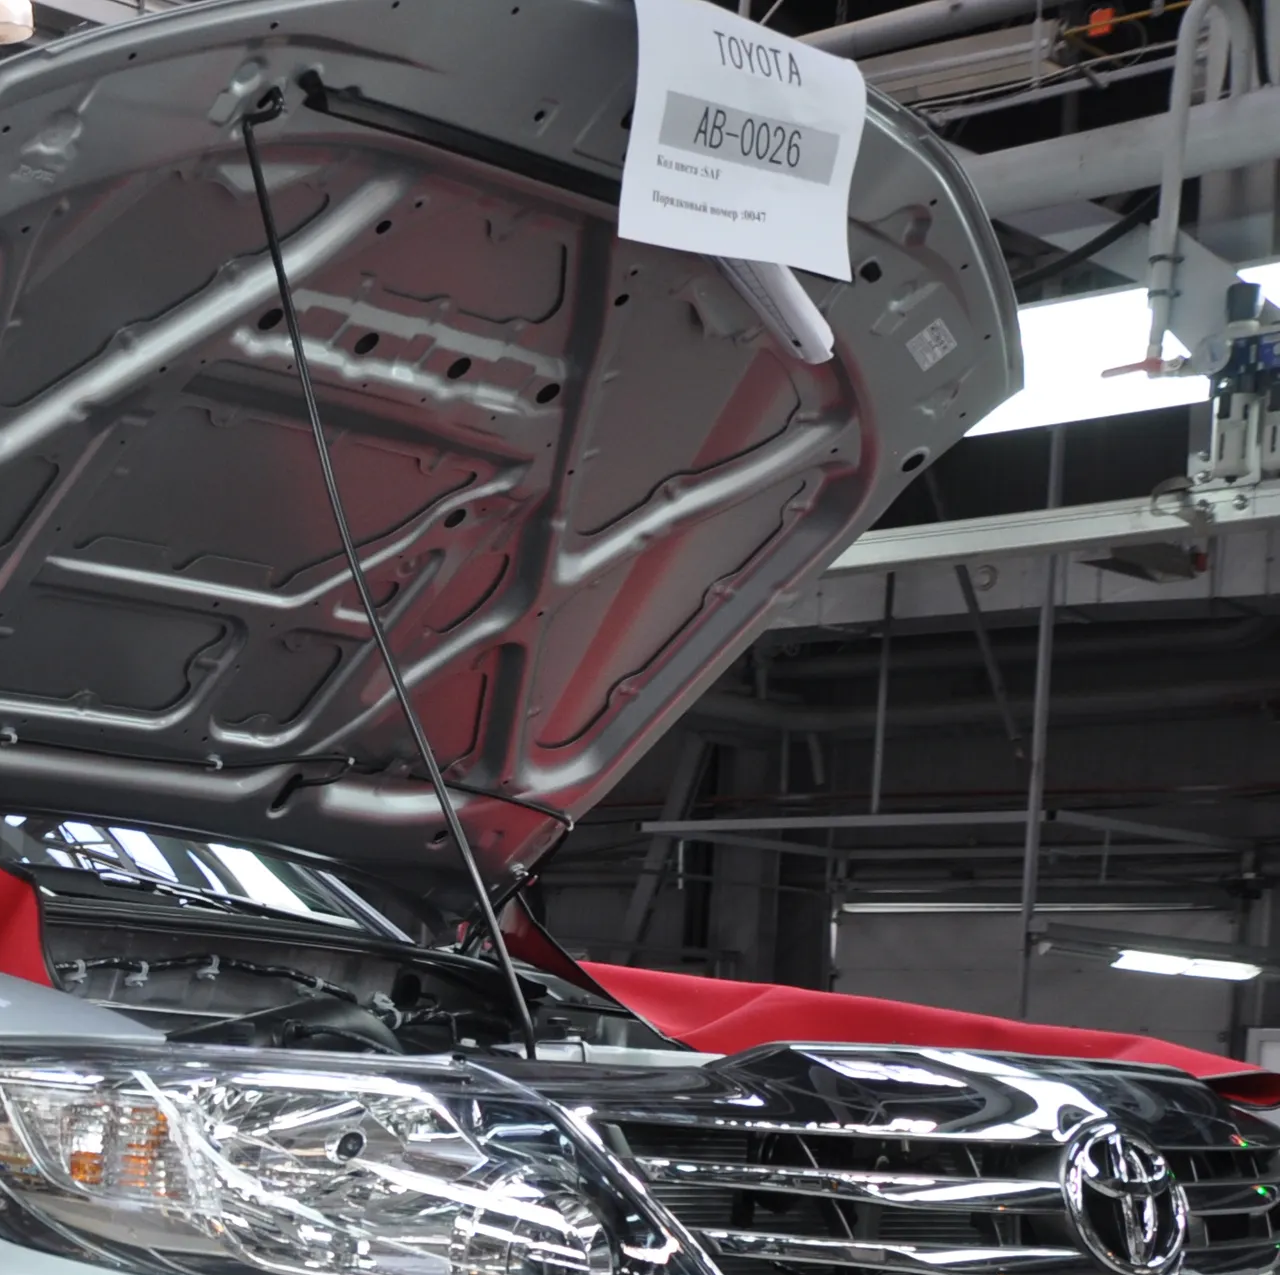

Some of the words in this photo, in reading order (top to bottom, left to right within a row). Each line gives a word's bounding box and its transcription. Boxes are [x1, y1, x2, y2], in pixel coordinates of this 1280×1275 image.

[713, 30, 802, 86] TOYOTA
[694, 107, 801, 168] AB-0026
[652, 190, 708, 213] Порядковый
[709, 207, 739, 222] номер
